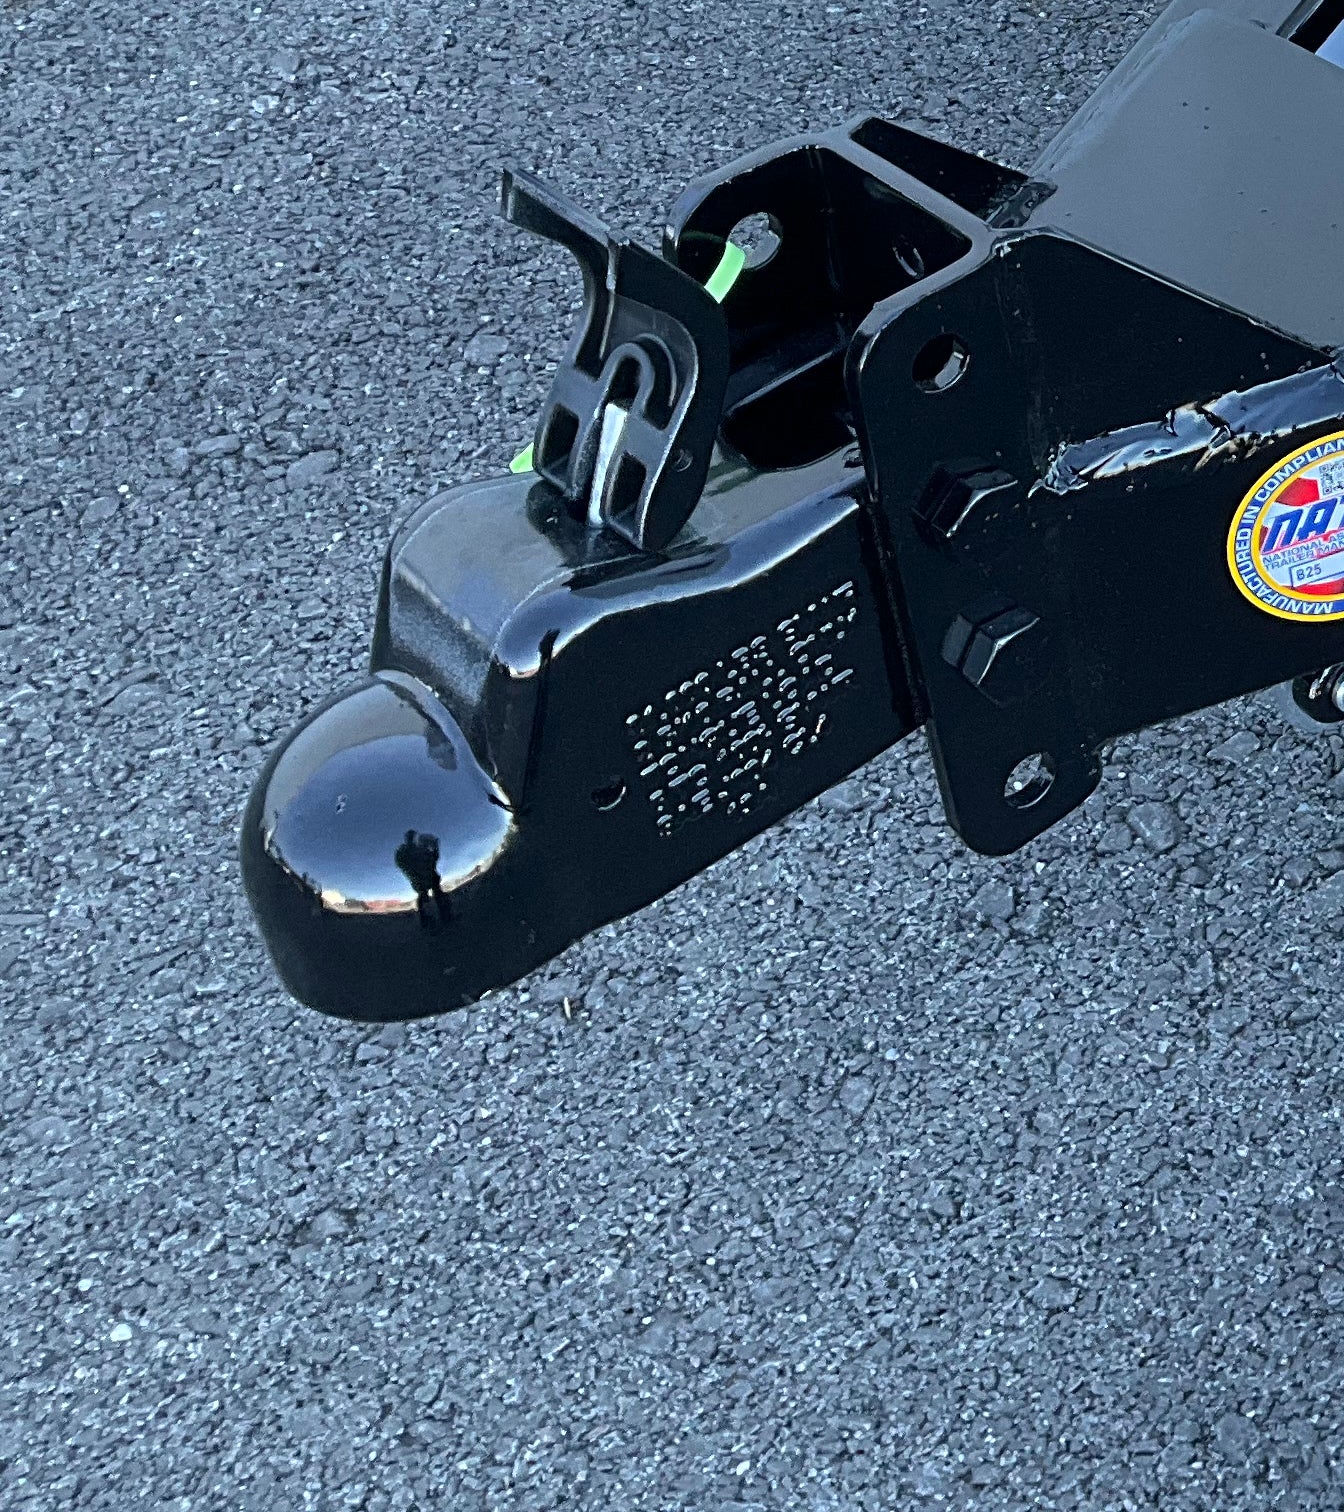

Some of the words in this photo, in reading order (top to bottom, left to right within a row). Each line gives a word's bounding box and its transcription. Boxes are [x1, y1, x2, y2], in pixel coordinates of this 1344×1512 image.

[1241, 506, 1256, 526] IN
[1262, 541, 1325, 564] NATIONAL
[1264, 549, 1315, 570] TRAILER
[1236, 528, 1333, 614] MANUFACTURED
[1296, 563, 1322, 582] B25
